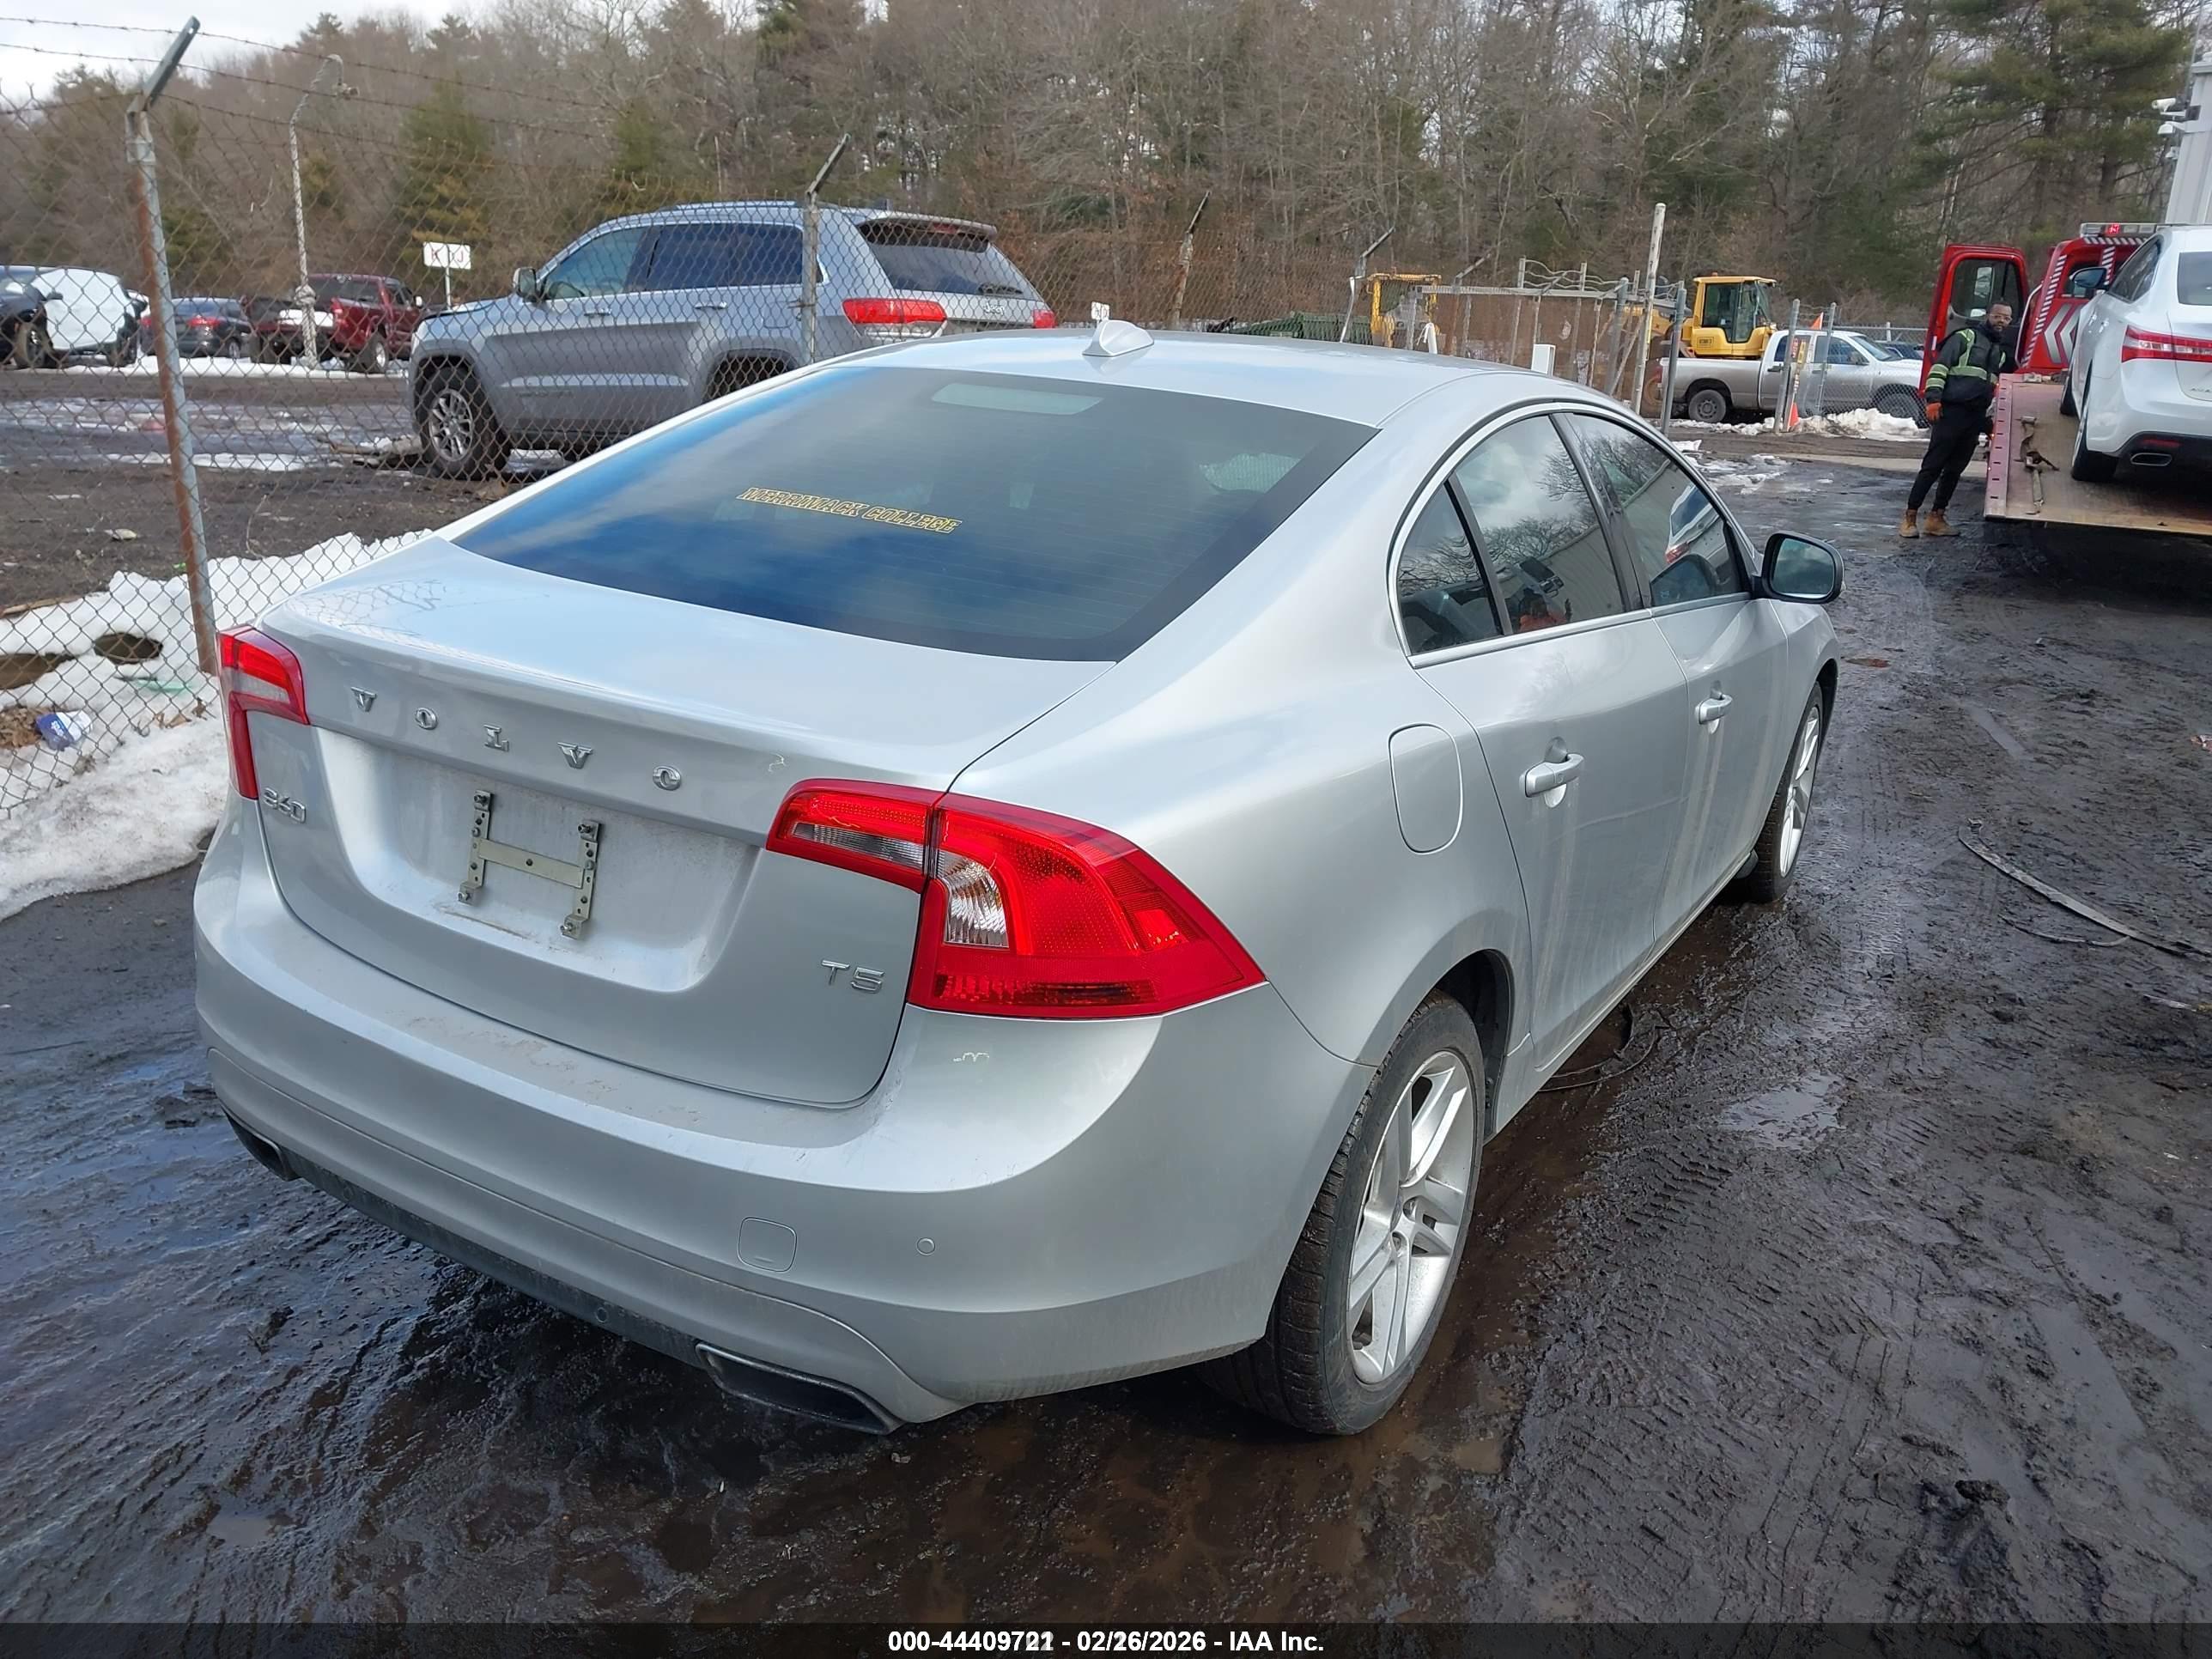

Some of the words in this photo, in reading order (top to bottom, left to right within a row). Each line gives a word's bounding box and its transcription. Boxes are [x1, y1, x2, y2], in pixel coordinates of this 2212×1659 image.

[736, 487, 869, 517] MERRIMACK
[861, 507, 963, 533] COLLEGE
[350, 686, 682, 791] VOLVO
[264, 787, 307, 823] S60
[821, 959, 885, 994] T5
